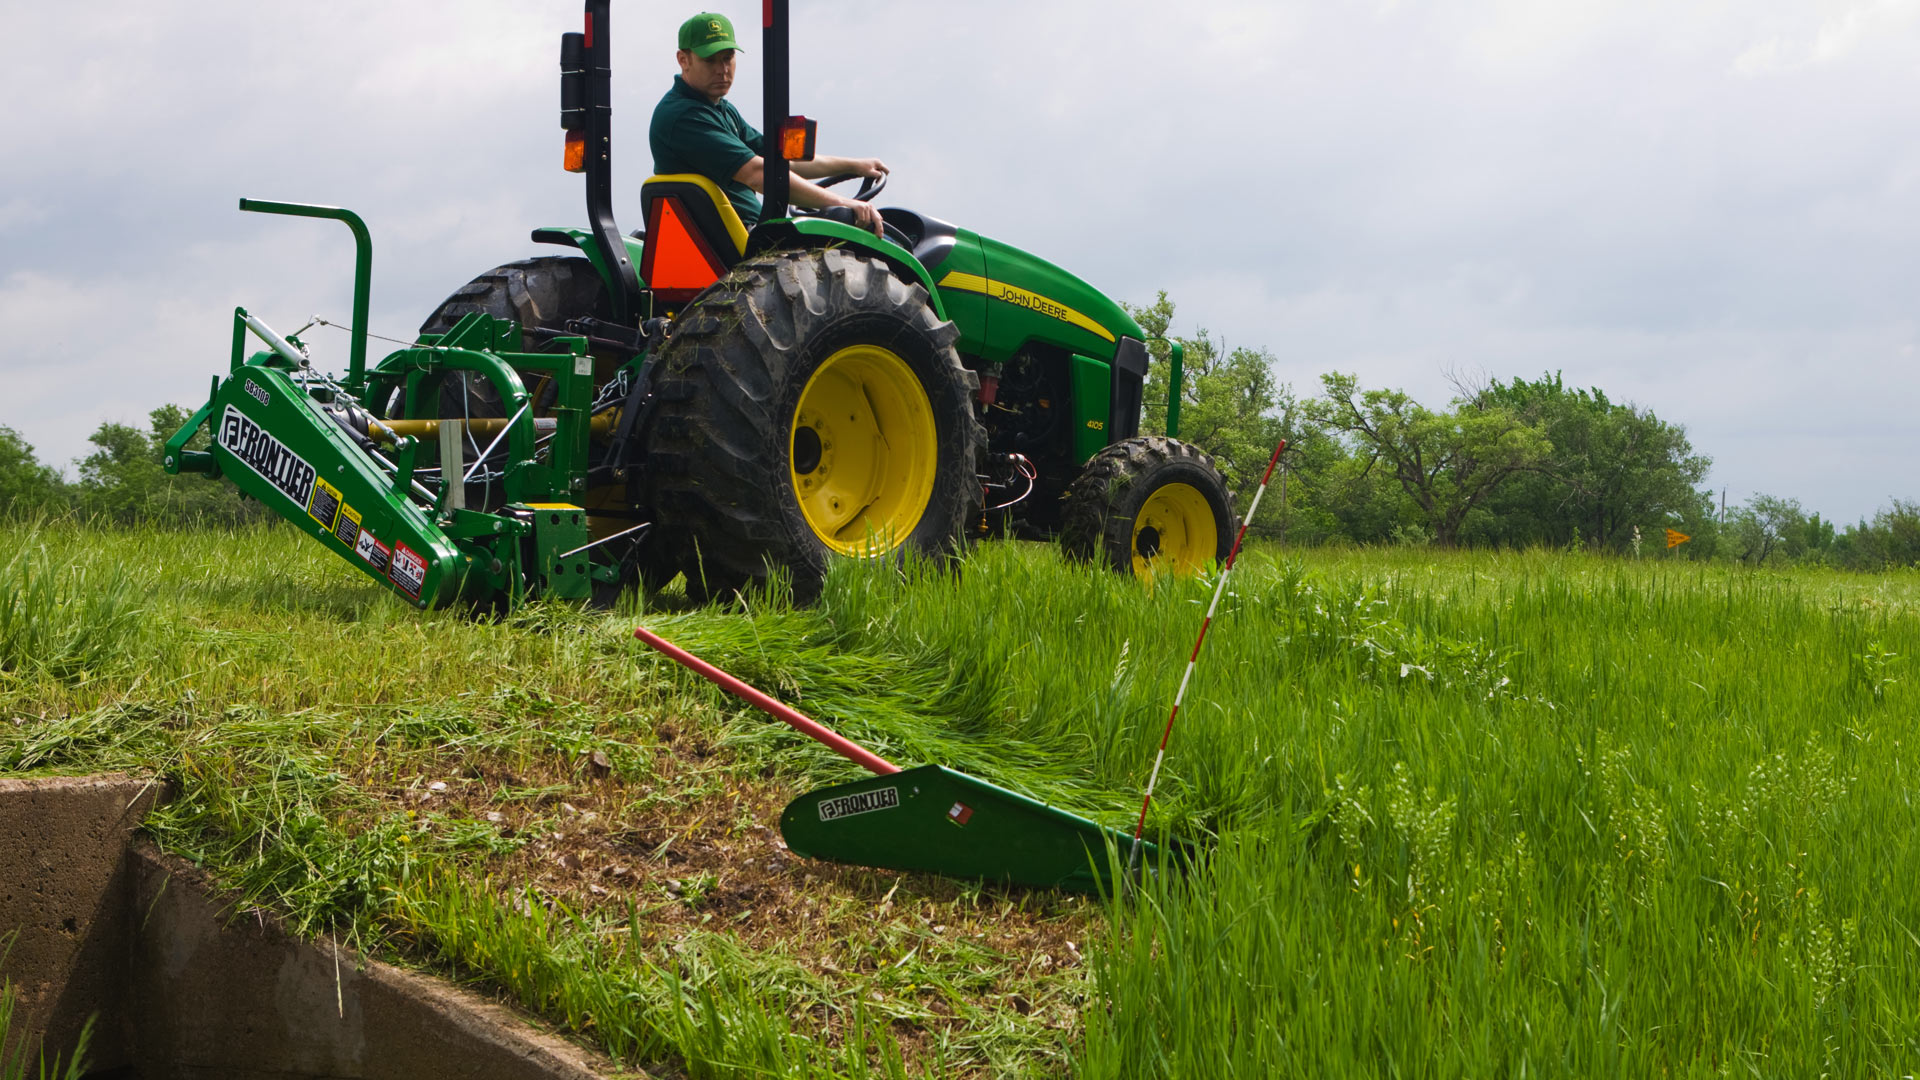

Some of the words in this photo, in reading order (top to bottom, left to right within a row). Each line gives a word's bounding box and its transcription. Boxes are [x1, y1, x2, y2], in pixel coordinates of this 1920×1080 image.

[999, 287, 1030, 306] JOHN
[1033, 297, 1067, 319] DEERE
[245, 379, 270, 405] SB3108
[1087, 420, 1103, 430] 4105
[240, 415, 315, 507] FRONTIER
[833, 788, 897, 816] FRONTIER
